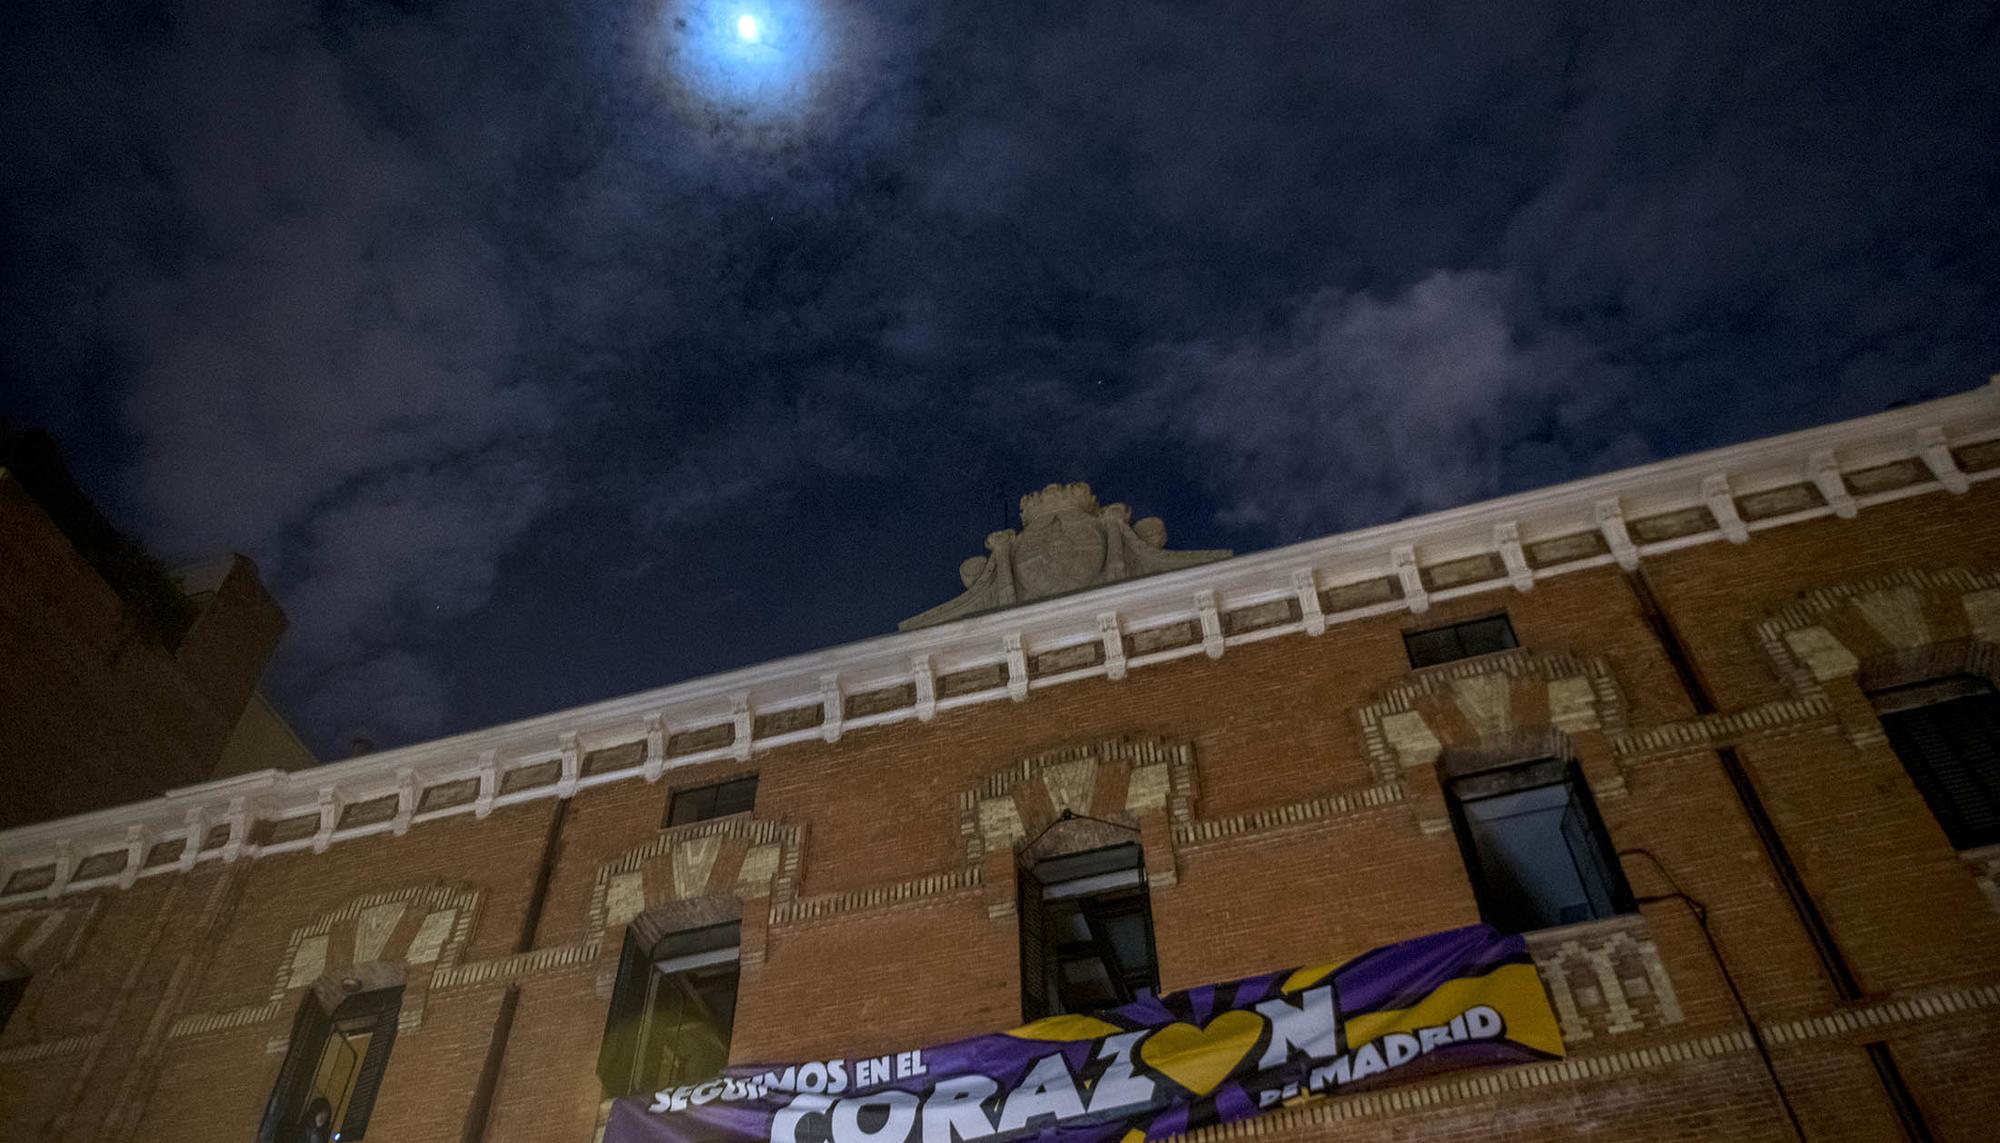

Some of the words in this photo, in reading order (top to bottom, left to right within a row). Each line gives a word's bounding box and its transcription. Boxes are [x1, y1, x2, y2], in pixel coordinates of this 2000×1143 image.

[648, 1059, 848, 1113] SEGUIMOS
[856, 1056, 890, 1089] EN
[897, 1049, 927, 1079] EL
[1309, 1005, 1502, 1092] MADRID
